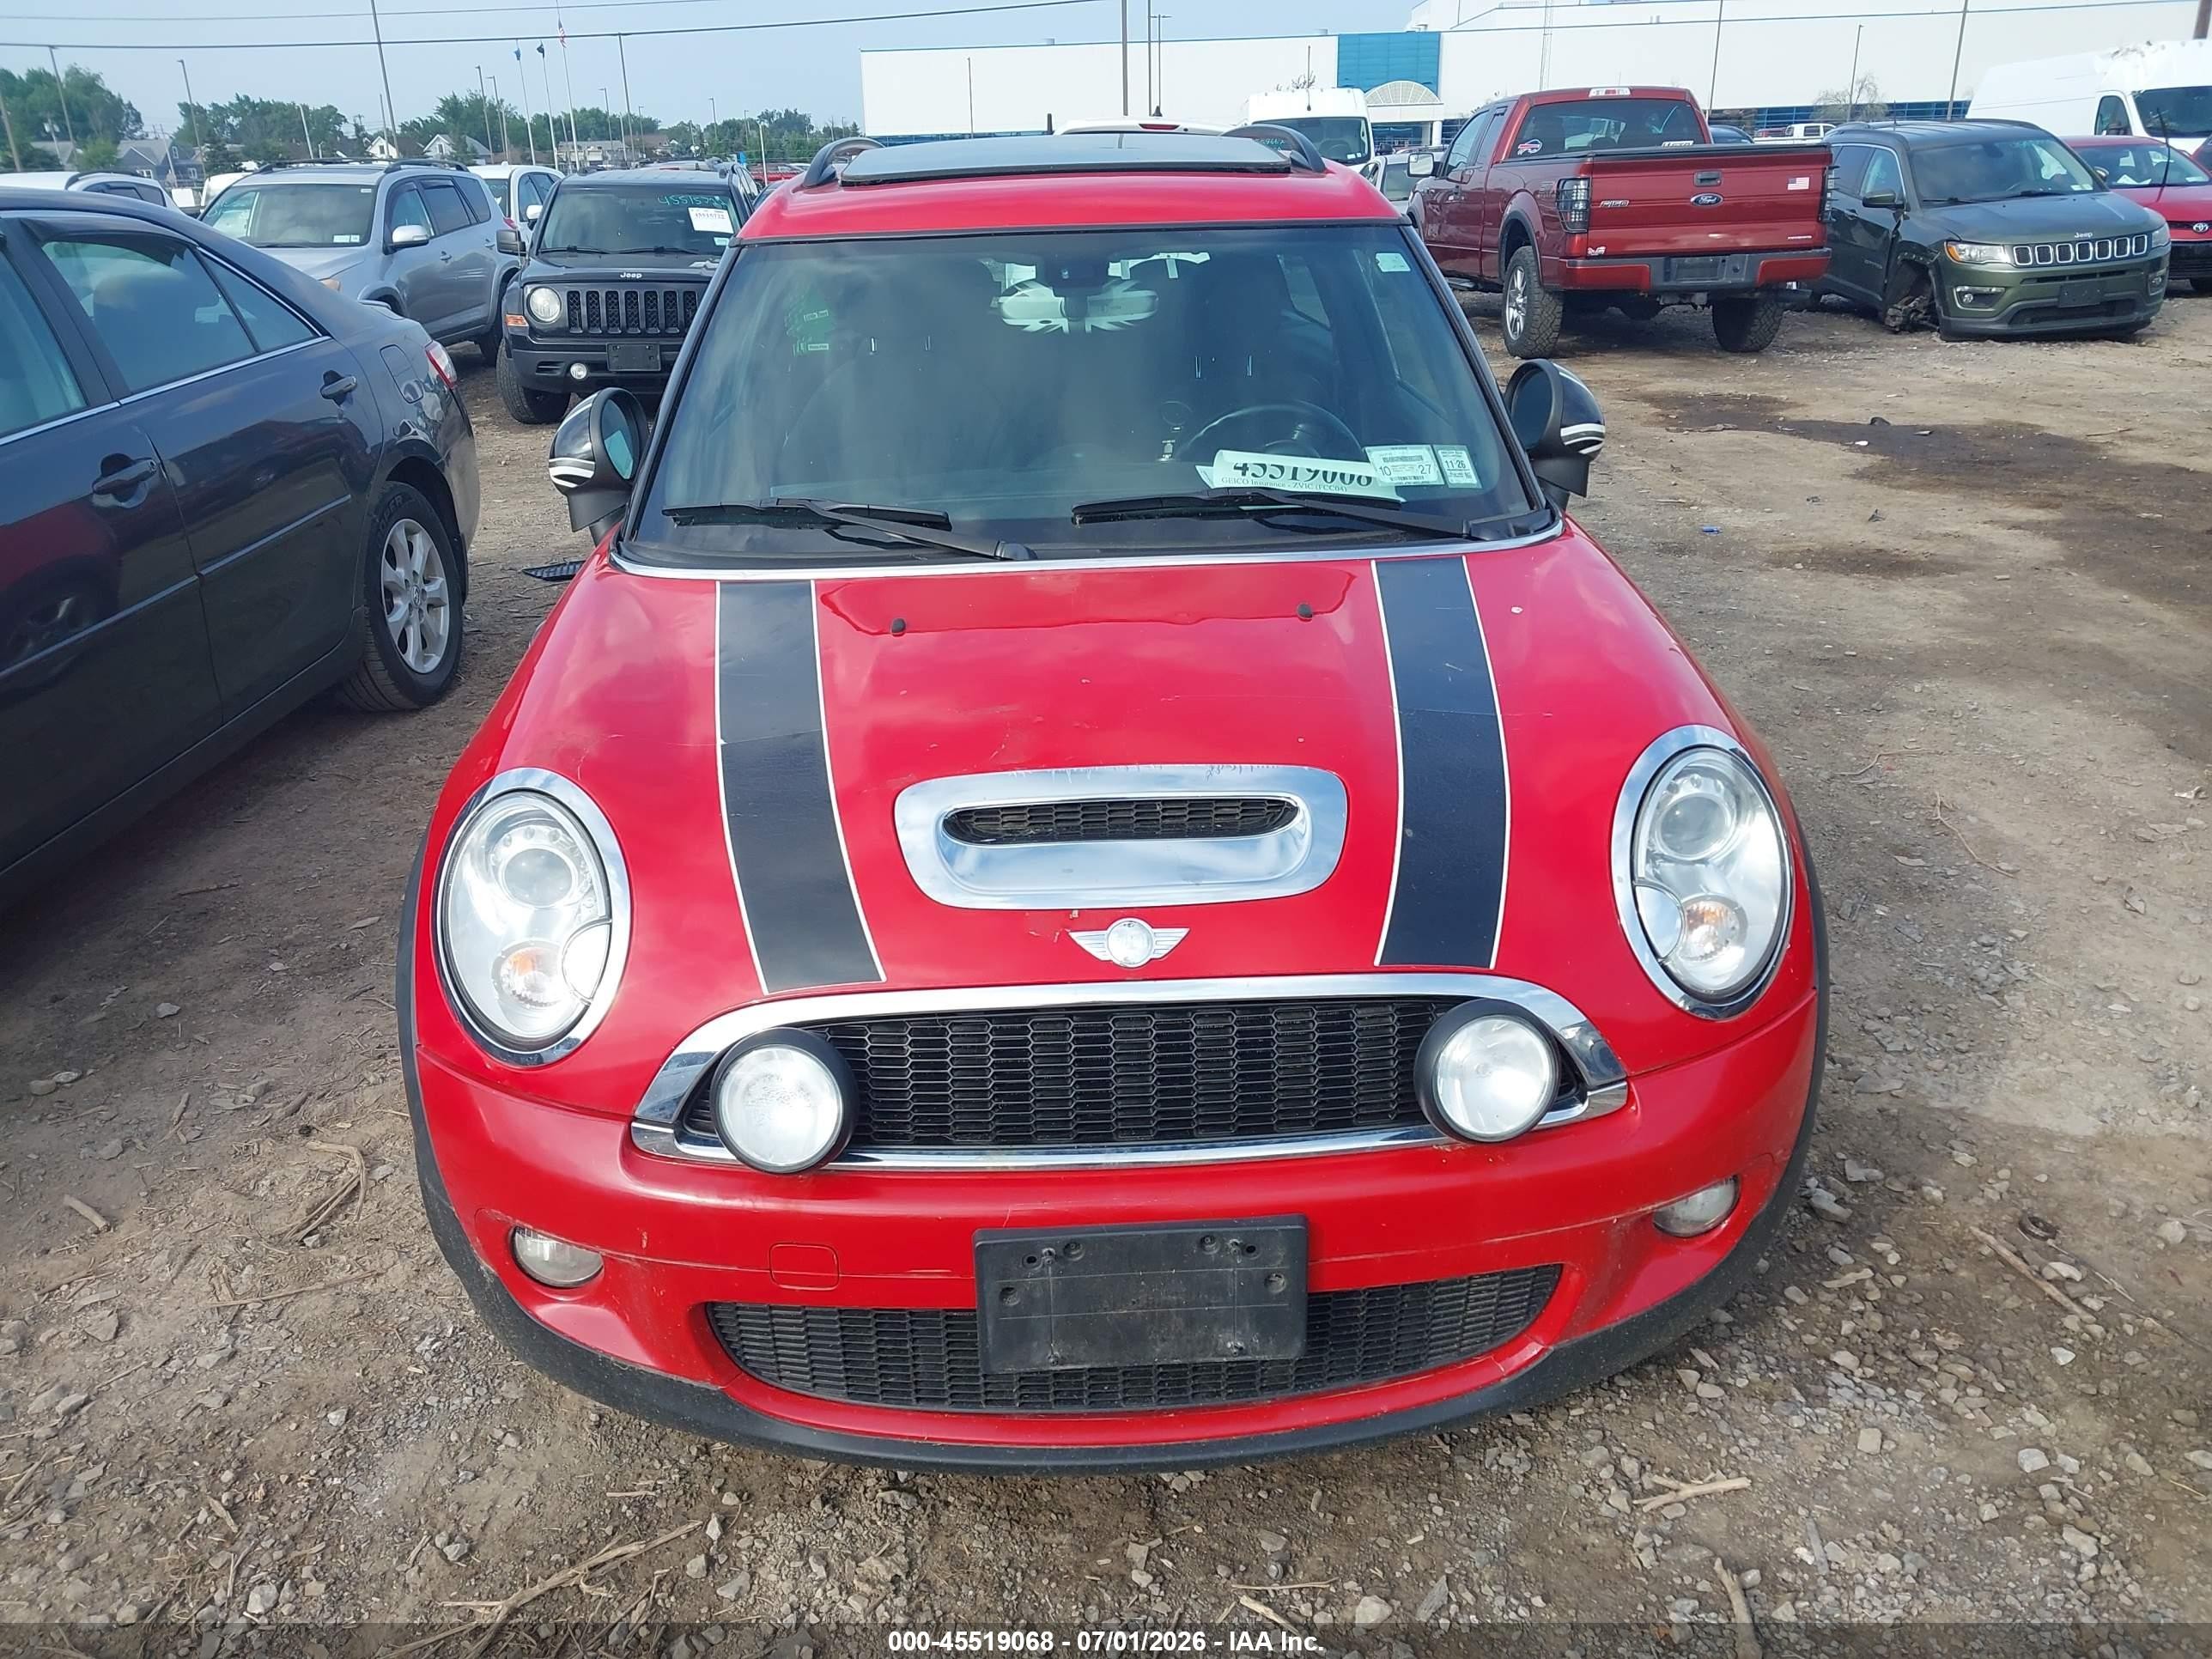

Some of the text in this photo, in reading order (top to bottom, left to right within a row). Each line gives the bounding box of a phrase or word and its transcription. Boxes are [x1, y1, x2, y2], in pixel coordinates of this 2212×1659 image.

[1456, 459, 1467, 469] 26
[1378, 465, 1392, 477] 10
[1418, 464, 1431, 475] 27
[1221, 477, 1249, 485] GEICO
[1251, 479, 1285, 488] Insurance
